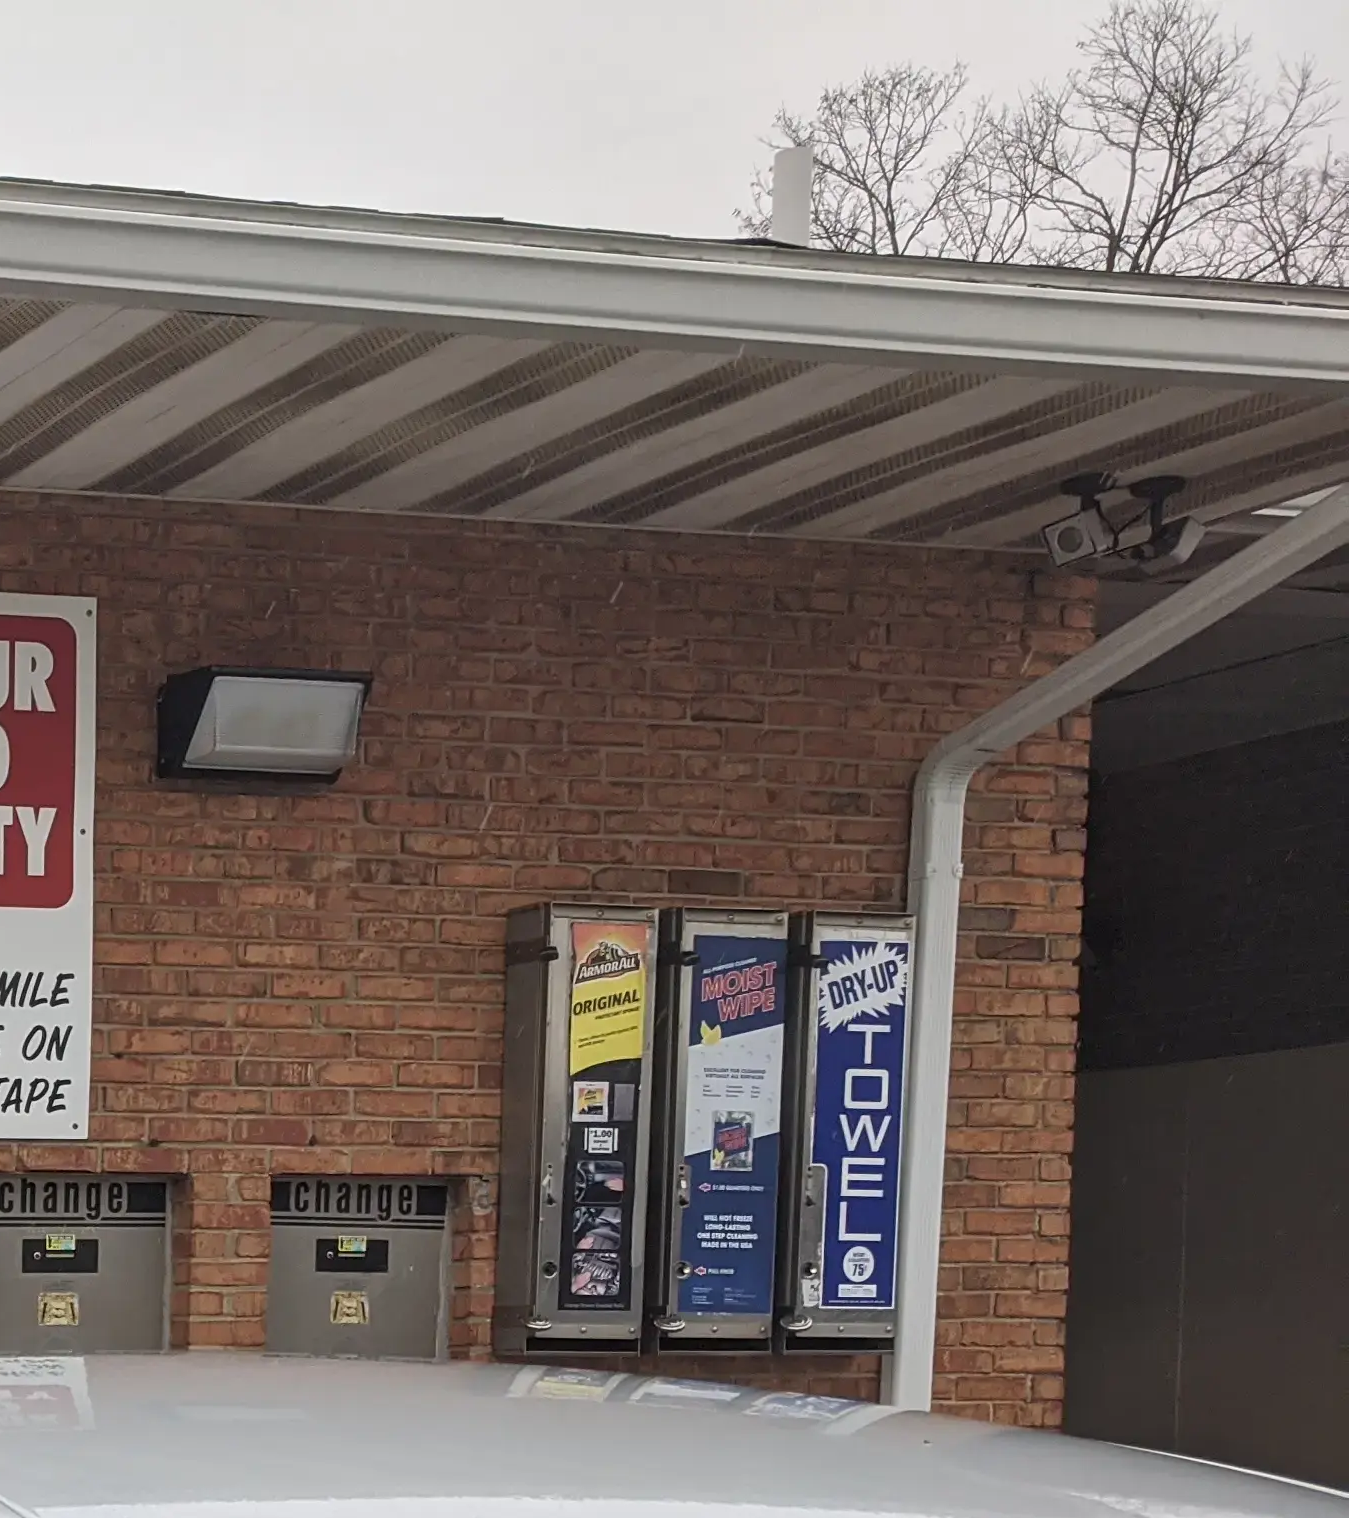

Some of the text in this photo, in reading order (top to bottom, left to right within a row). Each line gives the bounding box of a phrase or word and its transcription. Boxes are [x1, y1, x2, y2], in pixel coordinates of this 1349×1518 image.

[701, 961, 777, 1002] MOIST
[827, 958, 900, 1010] DRY-UP
[573, 989, 641, 1016] ORIGINAL
[717, 987, 776, 1022] WIPE
[21, 1024, 73, 1061] ON
[838, 1024, 893, 1242] TOWEL
[294, 1179, 415, 1222] change
